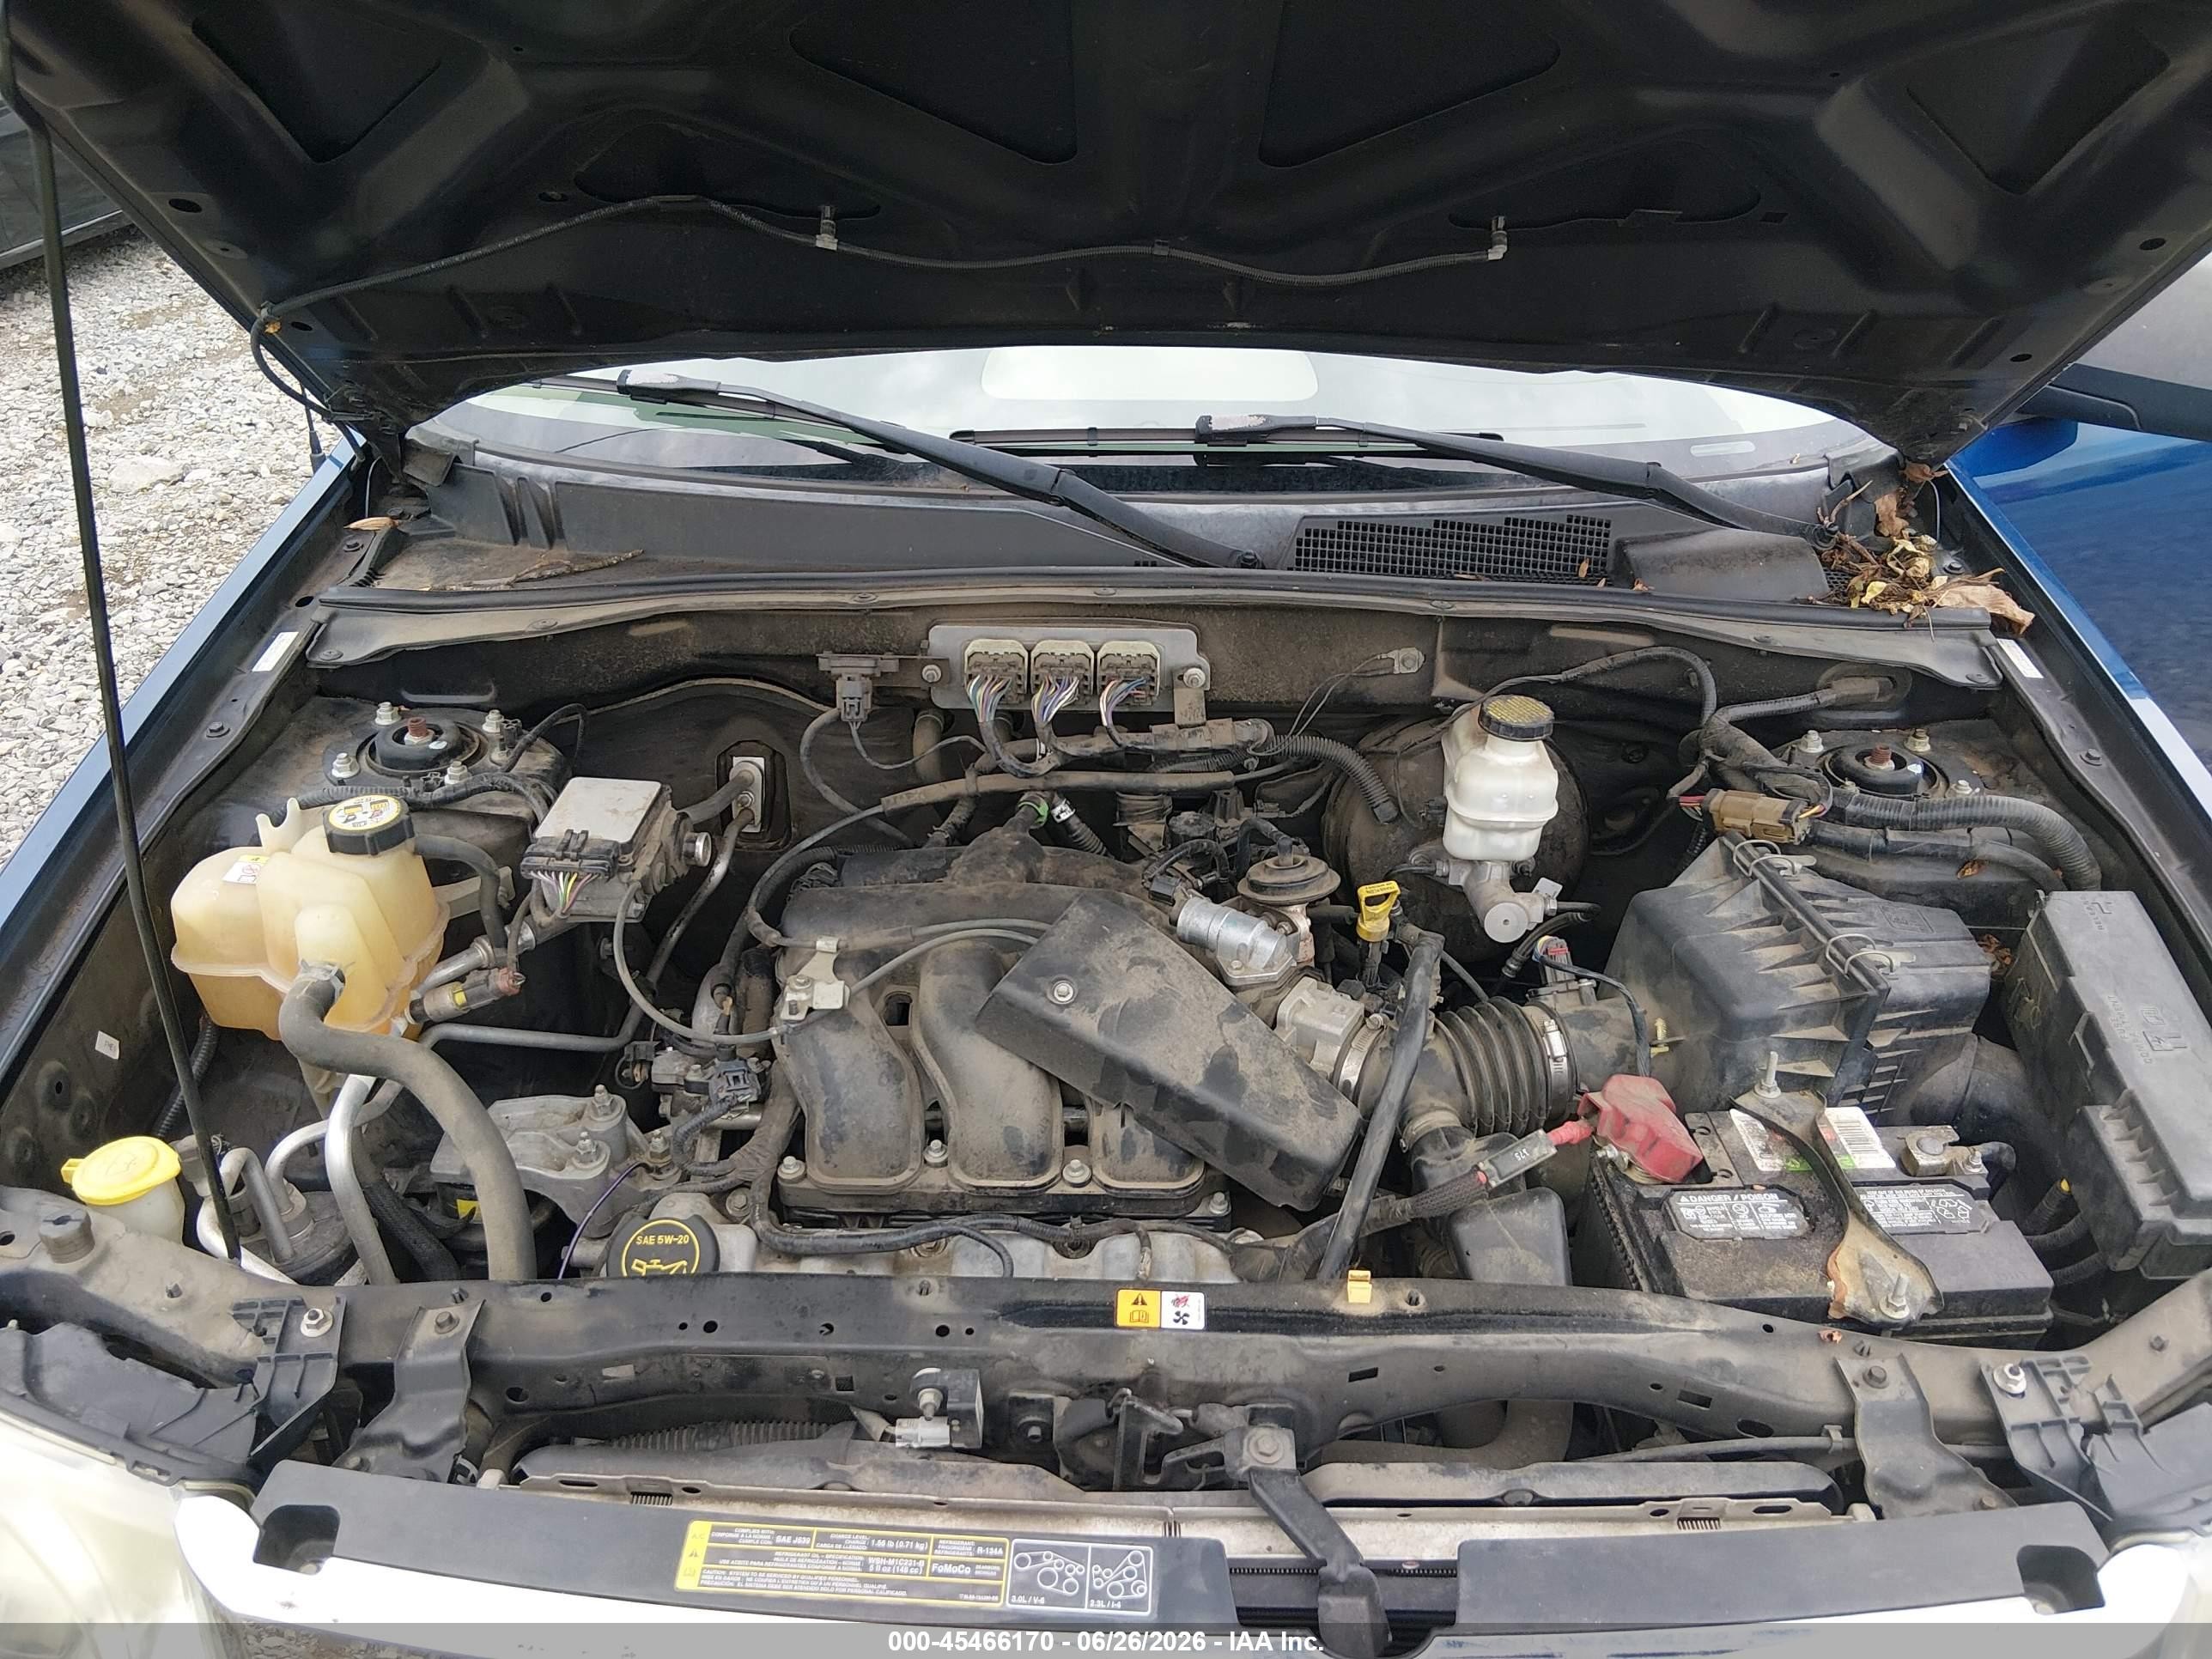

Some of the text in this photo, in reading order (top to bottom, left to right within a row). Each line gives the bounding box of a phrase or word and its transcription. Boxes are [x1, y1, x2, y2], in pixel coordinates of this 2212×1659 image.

[635, 1235, 690, 1245] SAE 5W-20
[977, 1546, 1003, 1555] R-134A
[932, 1563, 971, 1574] FoMoCo
[1033, 1595, 1045, 1604] V-6
